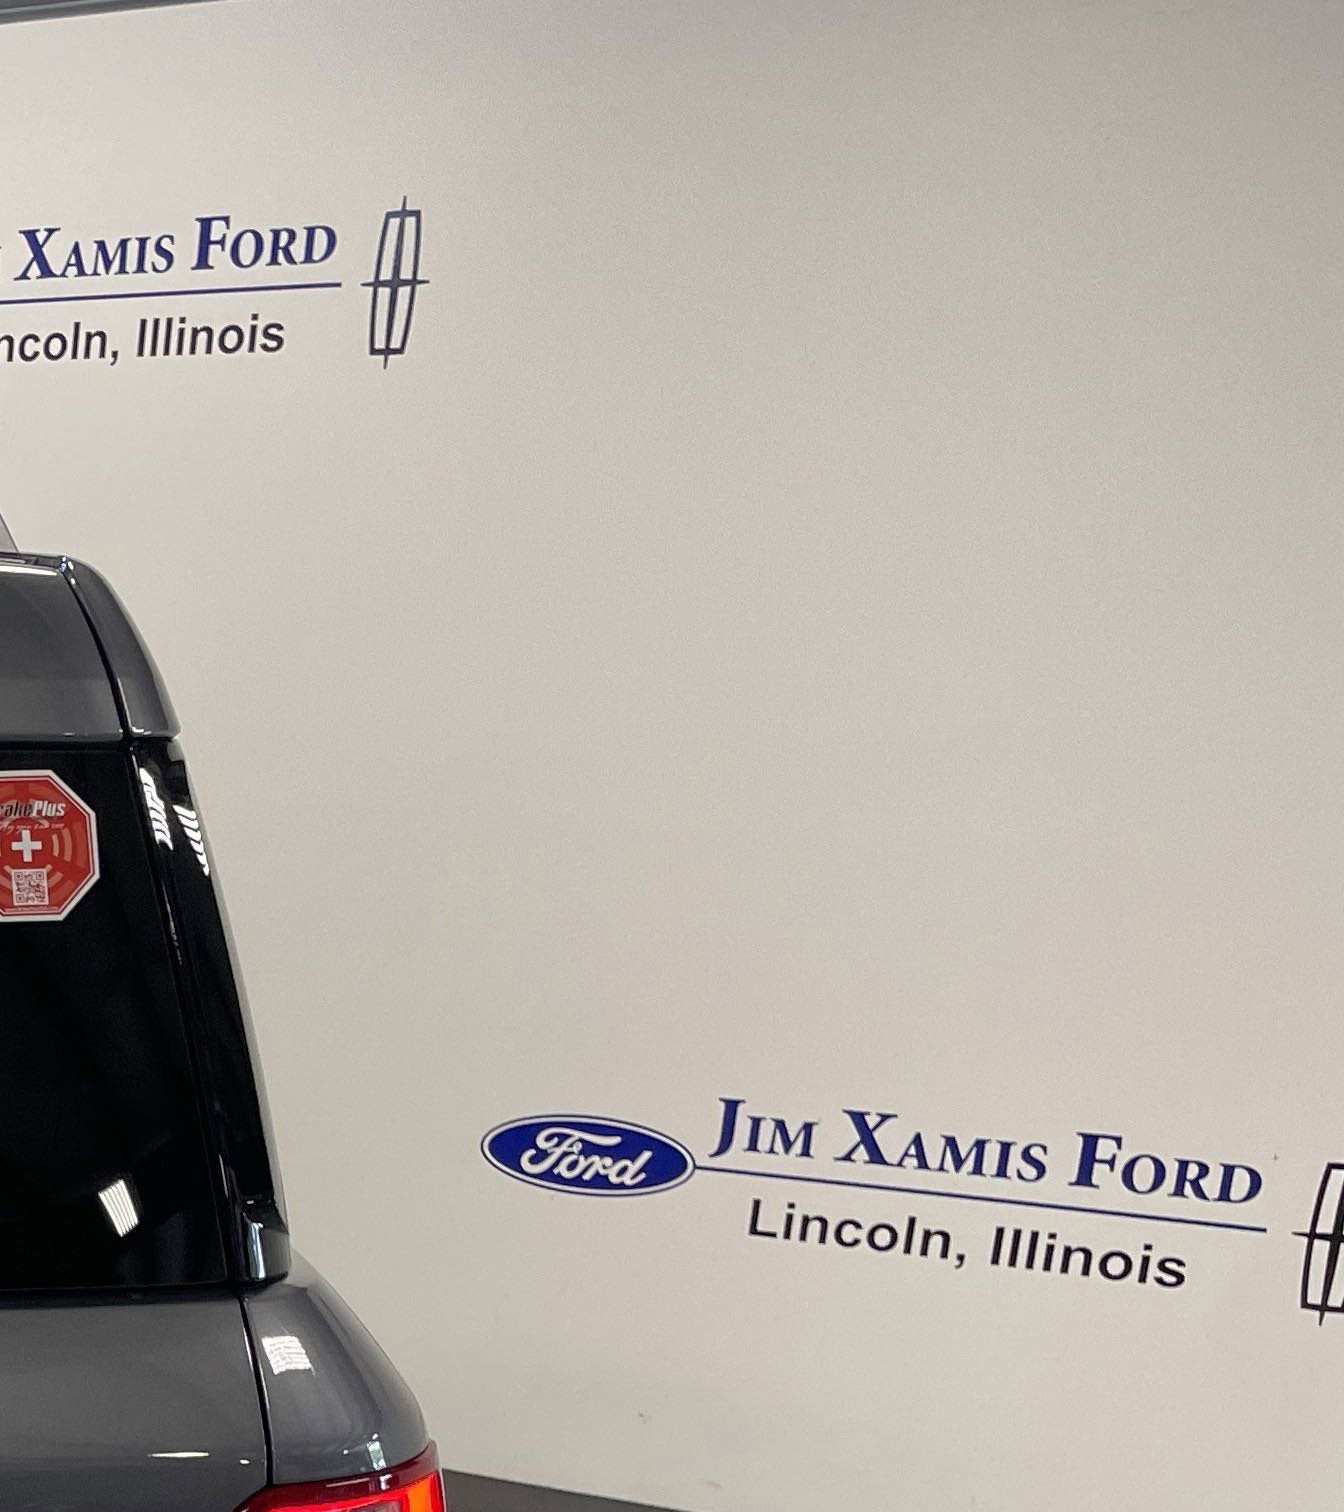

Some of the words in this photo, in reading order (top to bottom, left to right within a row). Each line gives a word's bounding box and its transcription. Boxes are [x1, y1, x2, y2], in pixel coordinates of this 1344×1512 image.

[14, 227, 175, 280] XAMIS
[193, 215, 338, 271] FORD
[137, 313, 285, 358] Illinois
[520, 1126, 647, 1187] Ford
[709, 1097, 819, 1158] JIM
[834, 1108, 1049, 1183] XAMIS
[1069, 1130, 1263, 1205] FORD
[748, 1197, 967, 1269] Lincoln,
[990, 1225, 1188, 1290] Illinois
